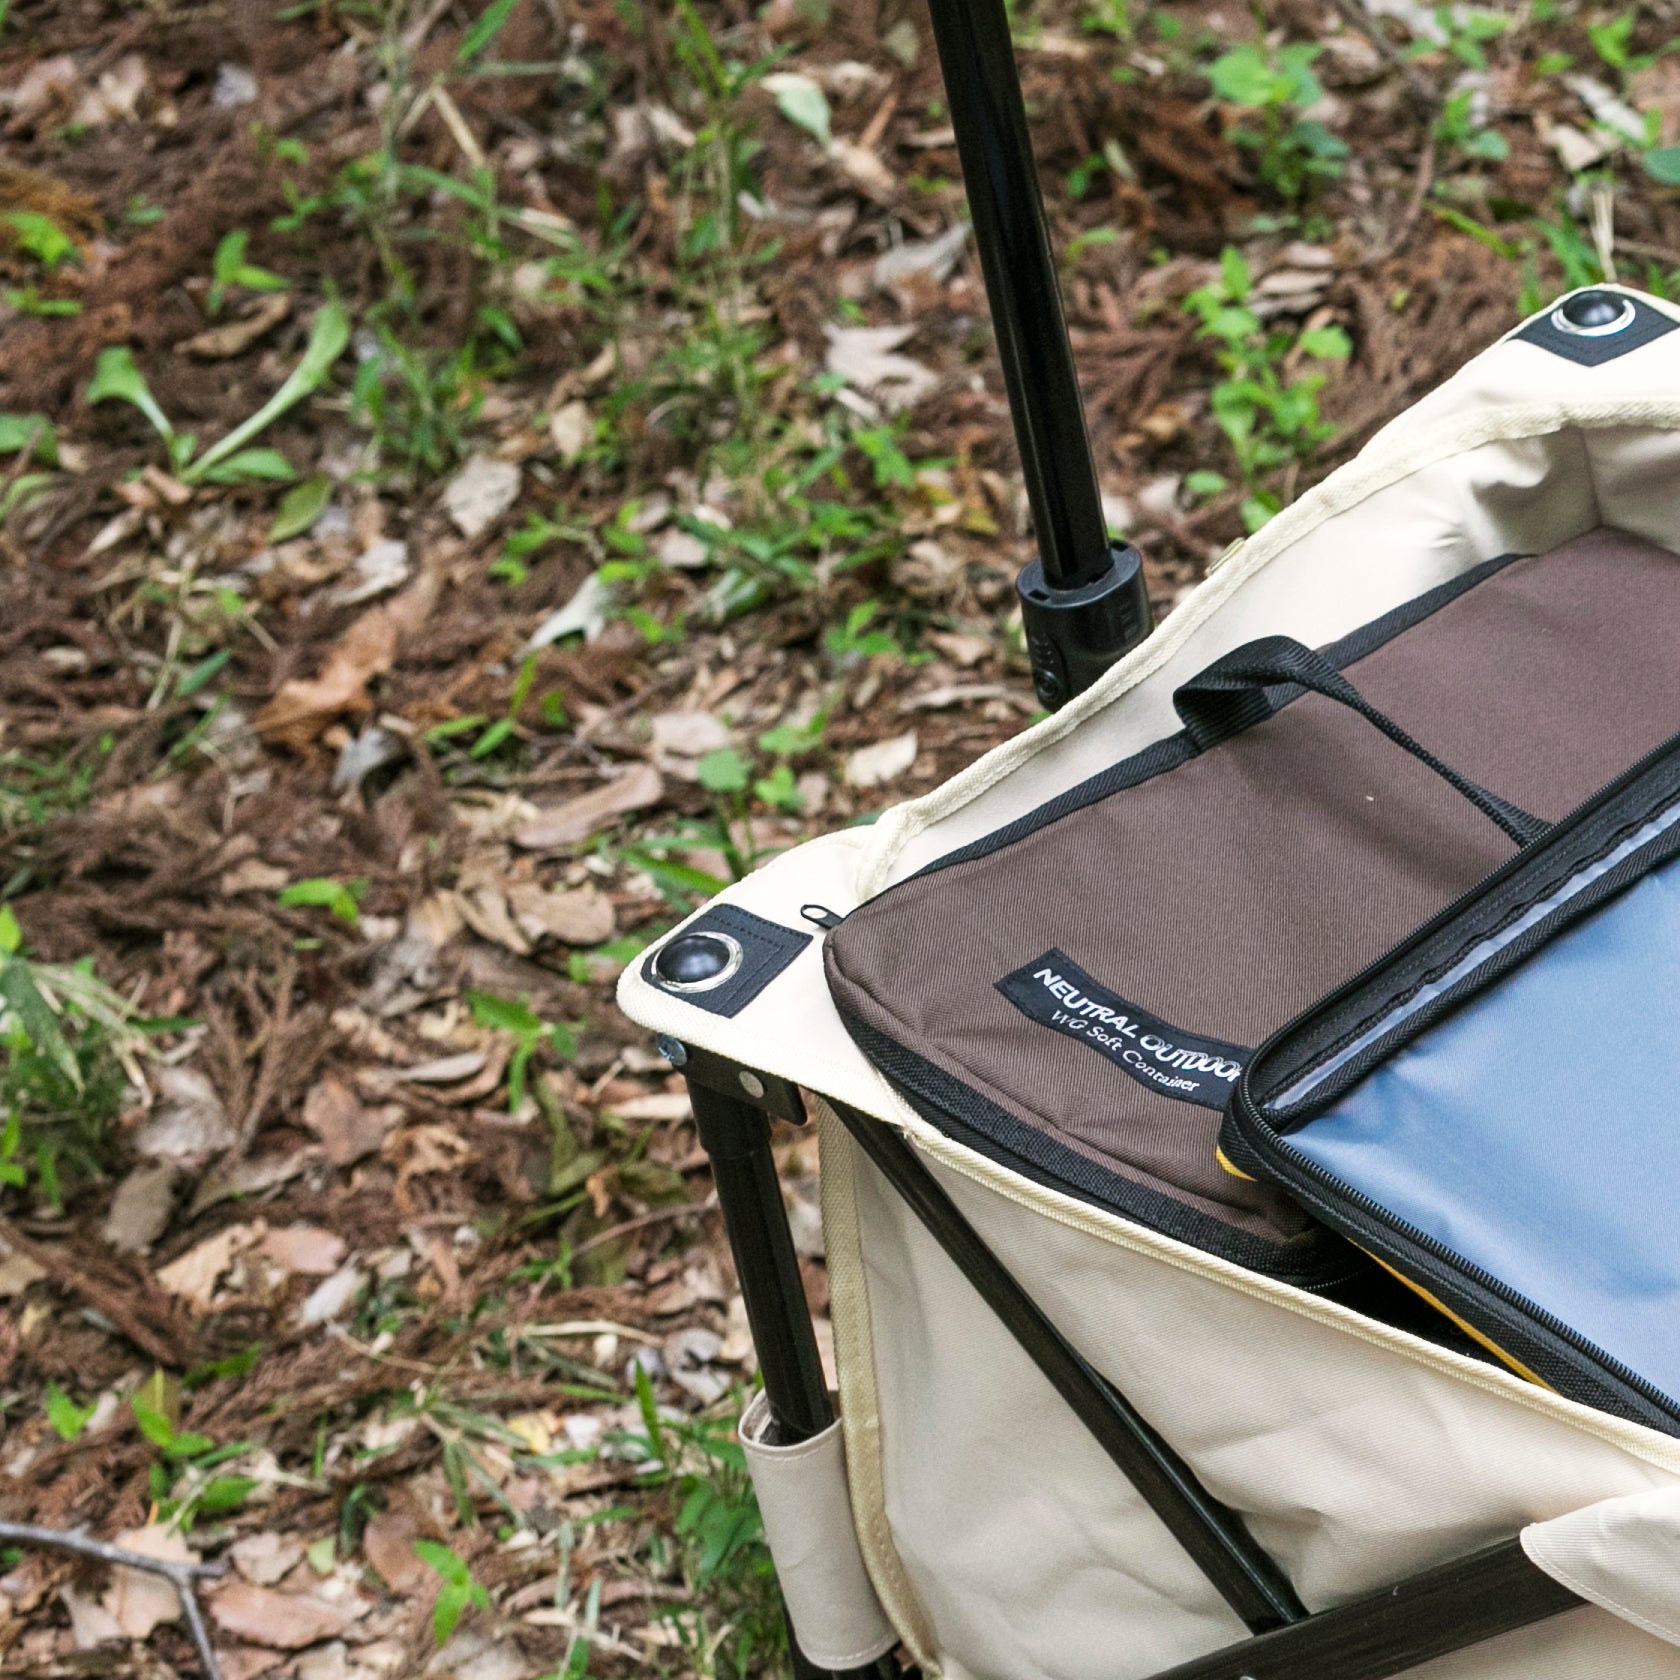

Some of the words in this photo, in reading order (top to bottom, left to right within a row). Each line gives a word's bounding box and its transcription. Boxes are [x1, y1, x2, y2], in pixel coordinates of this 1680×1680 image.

[1033, 968, 1138, 1038] NEUTRAL
[1051, 1009, 1086, 1030] WG
[1086, 1025, 1123, 1052] Soft
[1122, 1049, 1201, 1093] Container
